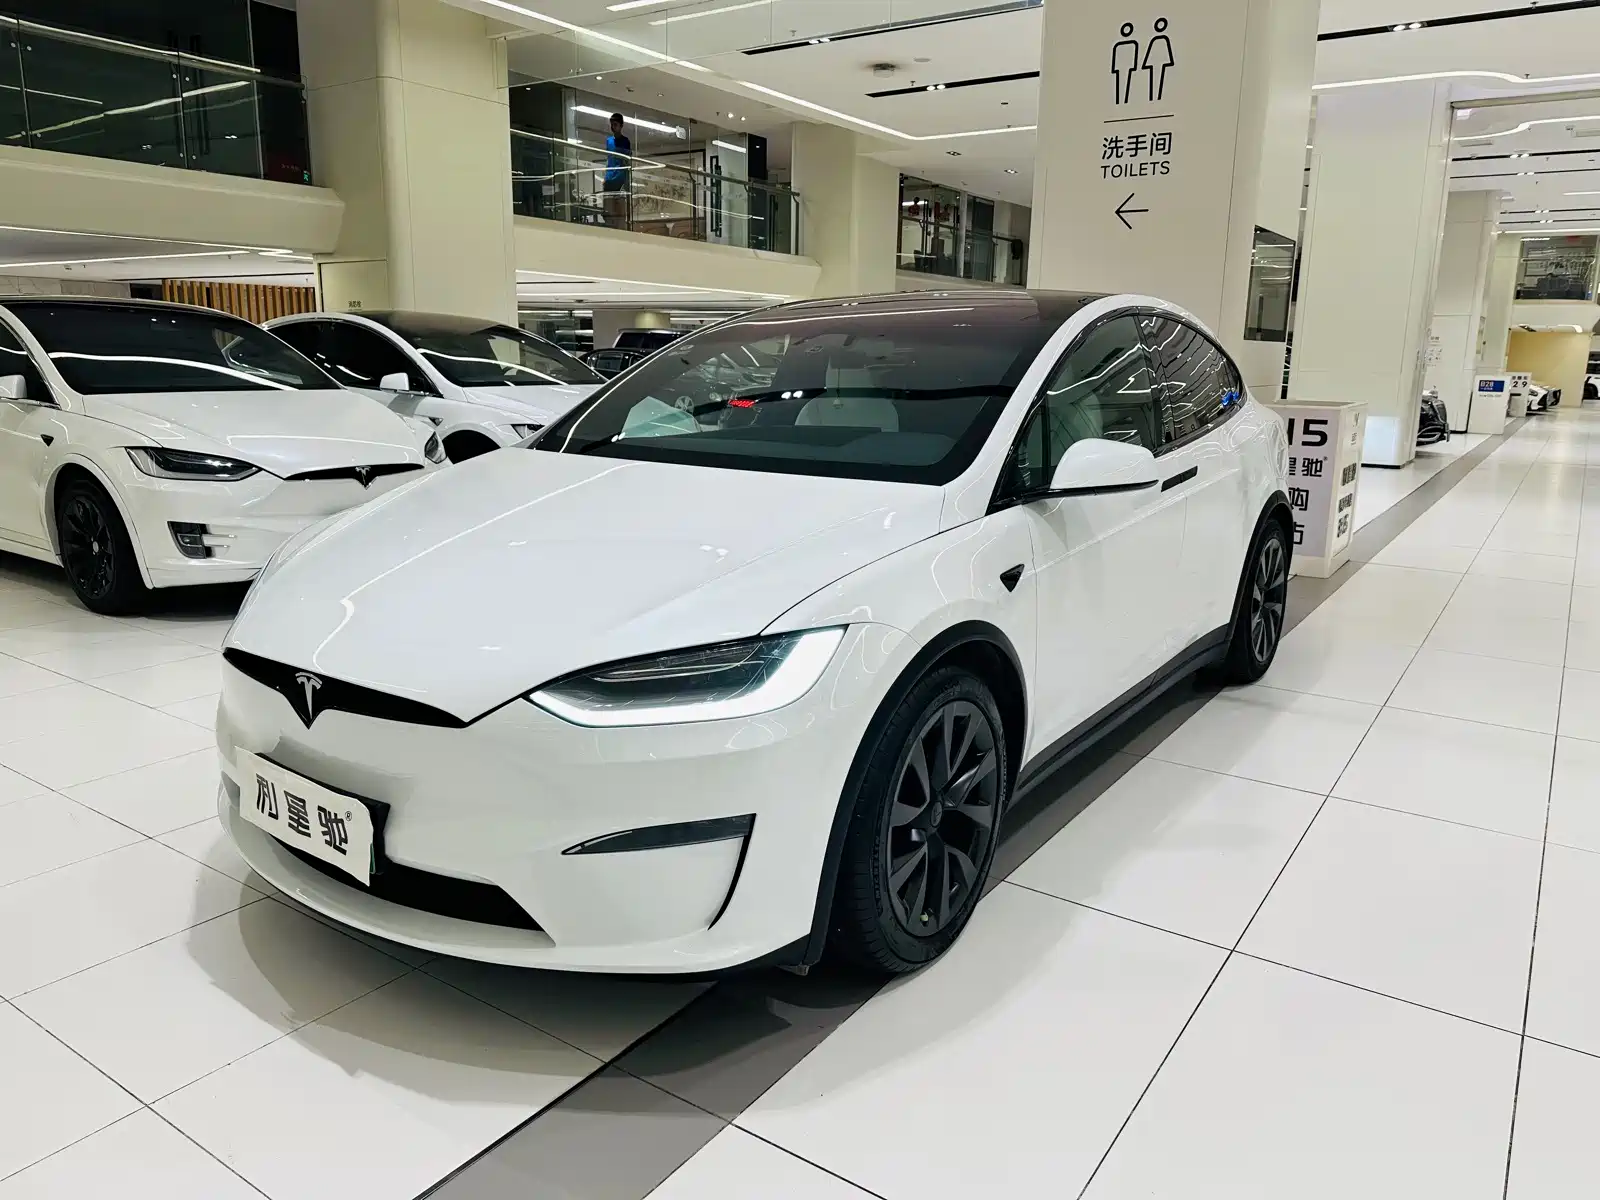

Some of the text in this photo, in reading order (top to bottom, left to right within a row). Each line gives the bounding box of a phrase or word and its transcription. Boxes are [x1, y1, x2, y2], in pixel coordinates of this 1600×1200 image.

[1101, 132, 1172, 160] 洗手间
[1100, 160, 1170, 179] TOILETS
[872, 835, 881, 899] MICHELIN
